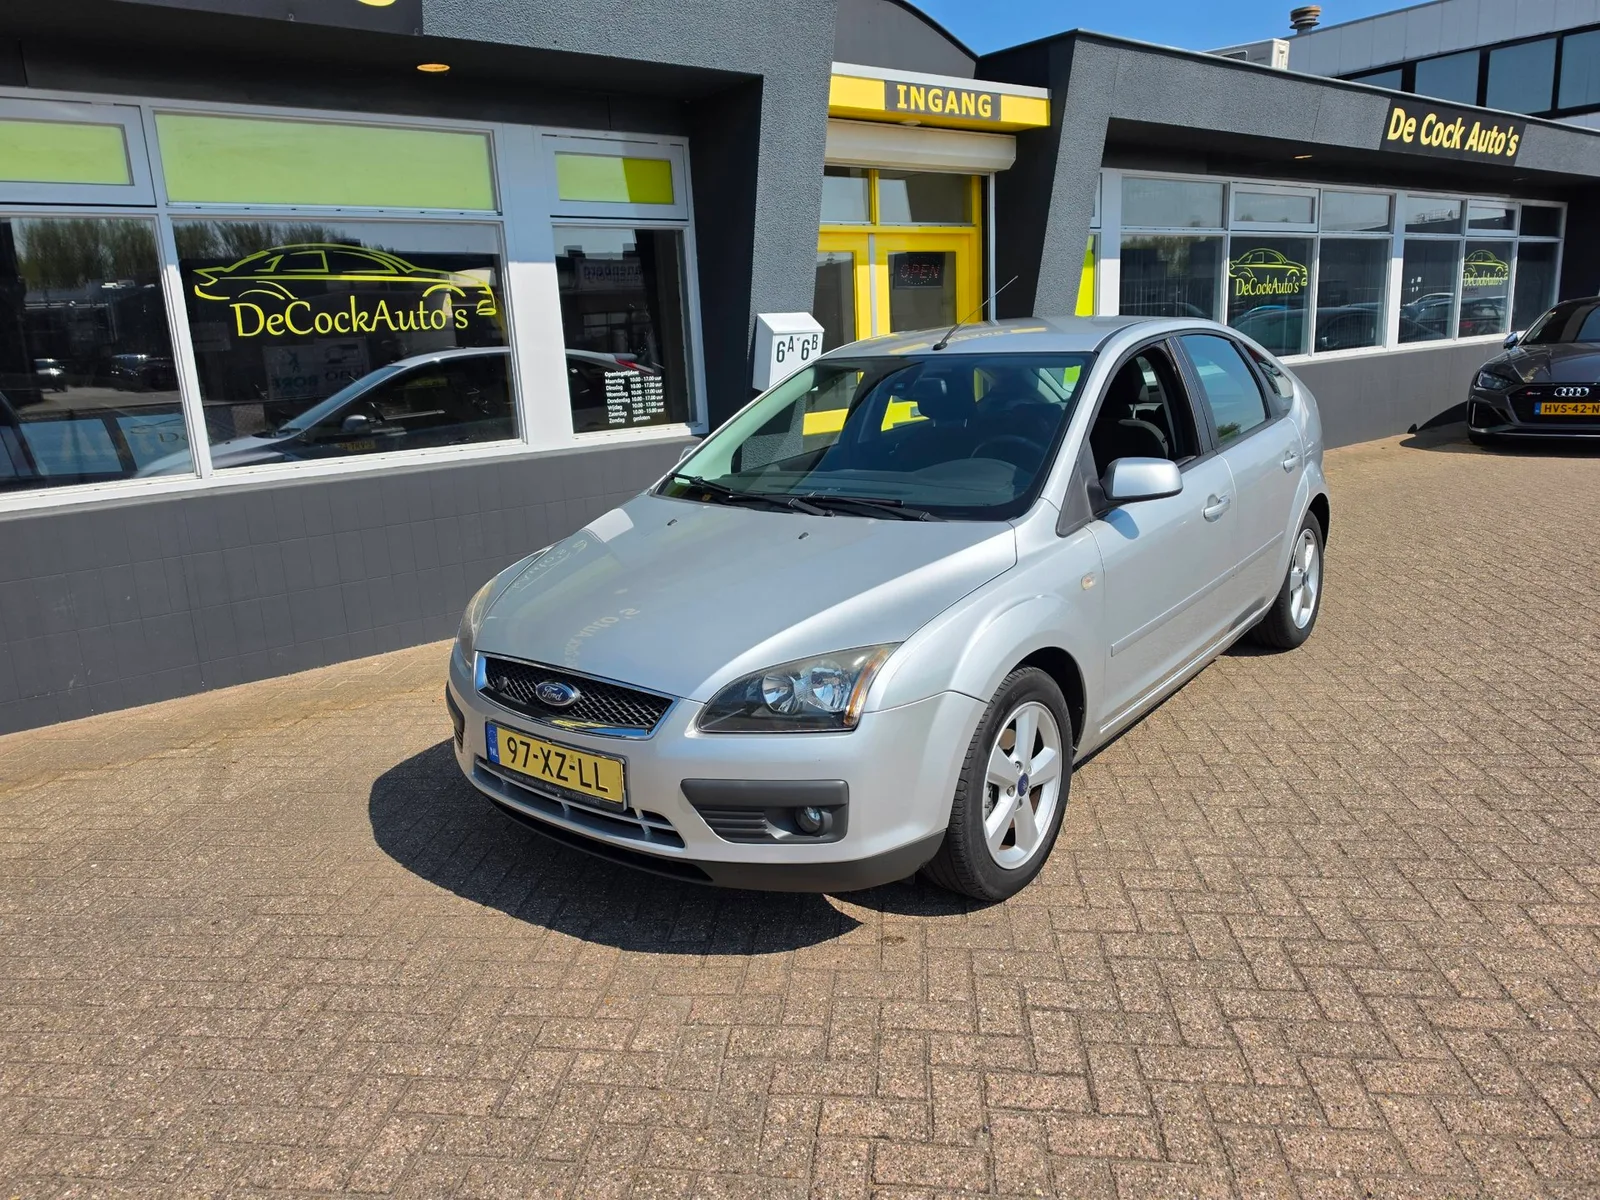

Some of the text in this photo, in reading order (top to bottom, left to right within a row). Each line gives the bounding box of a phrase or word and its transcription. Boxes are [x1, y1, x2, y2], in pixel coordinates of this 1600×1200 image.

[896, 84, 992, 118] INGANG
[1387, 107, 1520, 157] De Cock Auto's
[900, 263, 941, 279] OPEN
[1235, 274, 1300, 296] DeCockAuto's
[229, 294, 470, 338] DeCockAuto's
[541, 685, 564, 701] Ford
[489, 746, 499, 758] NL
[506, 736, 609, 793] 97-XZ-LL
